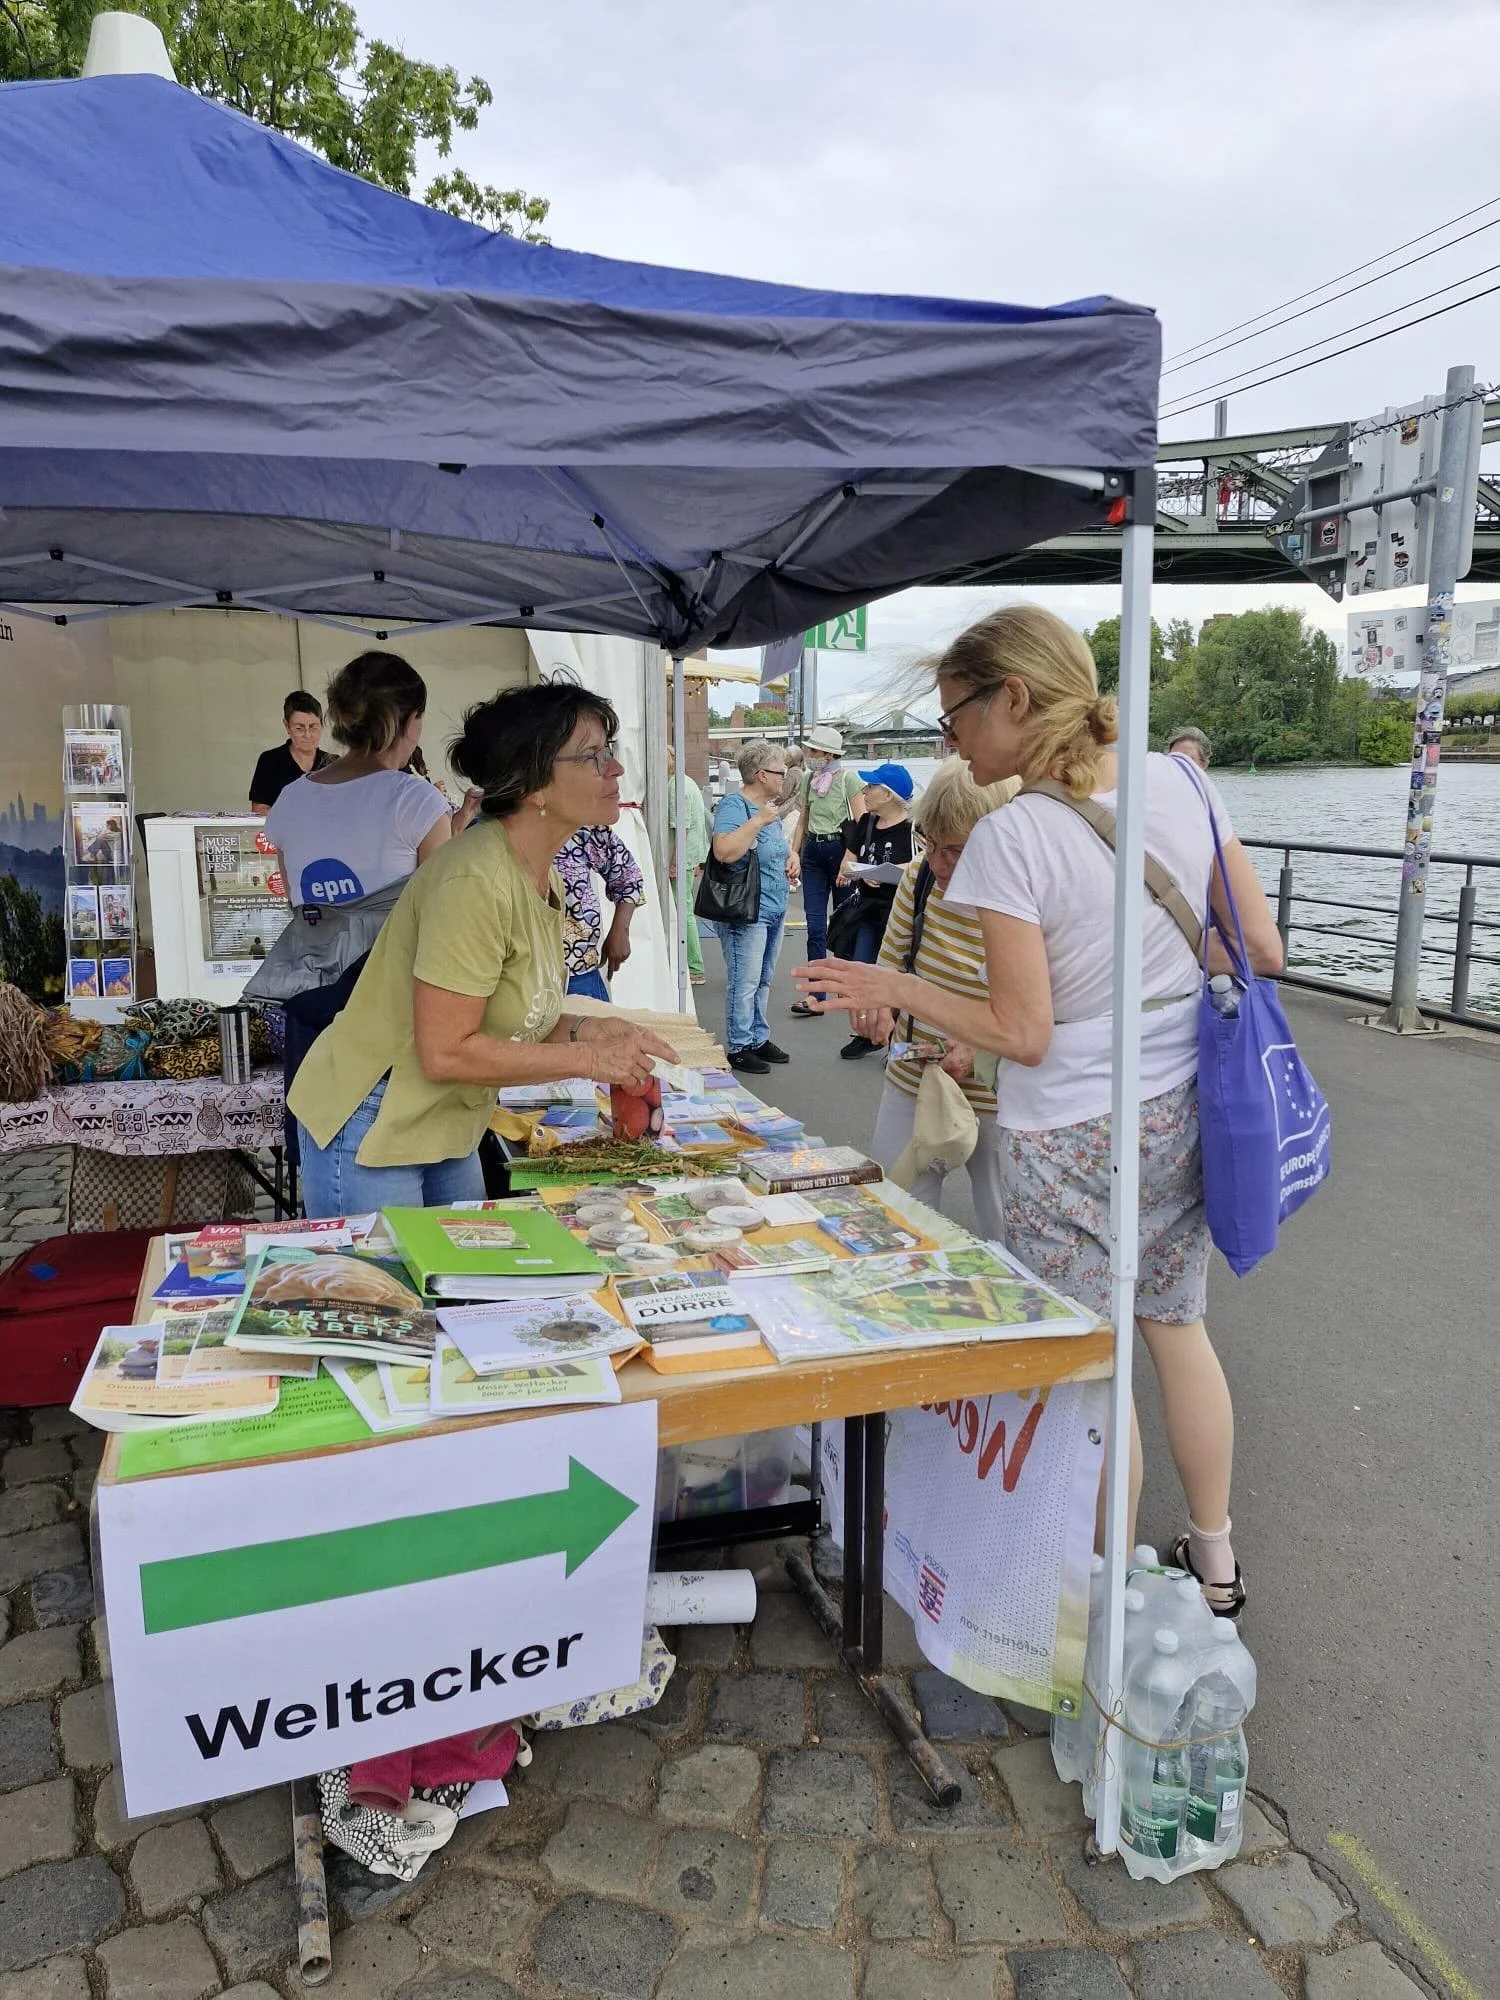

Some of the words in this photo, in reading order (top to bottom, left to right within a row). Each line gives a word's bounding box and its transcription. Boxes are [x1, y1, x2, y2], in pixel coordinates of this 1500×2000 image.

[206, 837, 237, 848] MUSE
[207, 846, 231, 856] UMS
[207, 855, 236, 864] UFER
[208, 863, 234, 872] FEST
[311, 878, 357, 902] epn
[1280, 1151, 1316, 1182] EUROPE
[815, 1178, 827, 1188] DEN
[828, 1175, 850, 1187] RETTET
[638, 1298, 735, 1318] DÜRRE
[268, 1308, 414, 1331] DRECKS
[271, 1319, 408, 1339] ARBEIT
[185, 1631, 584, 1761] Weltacker
